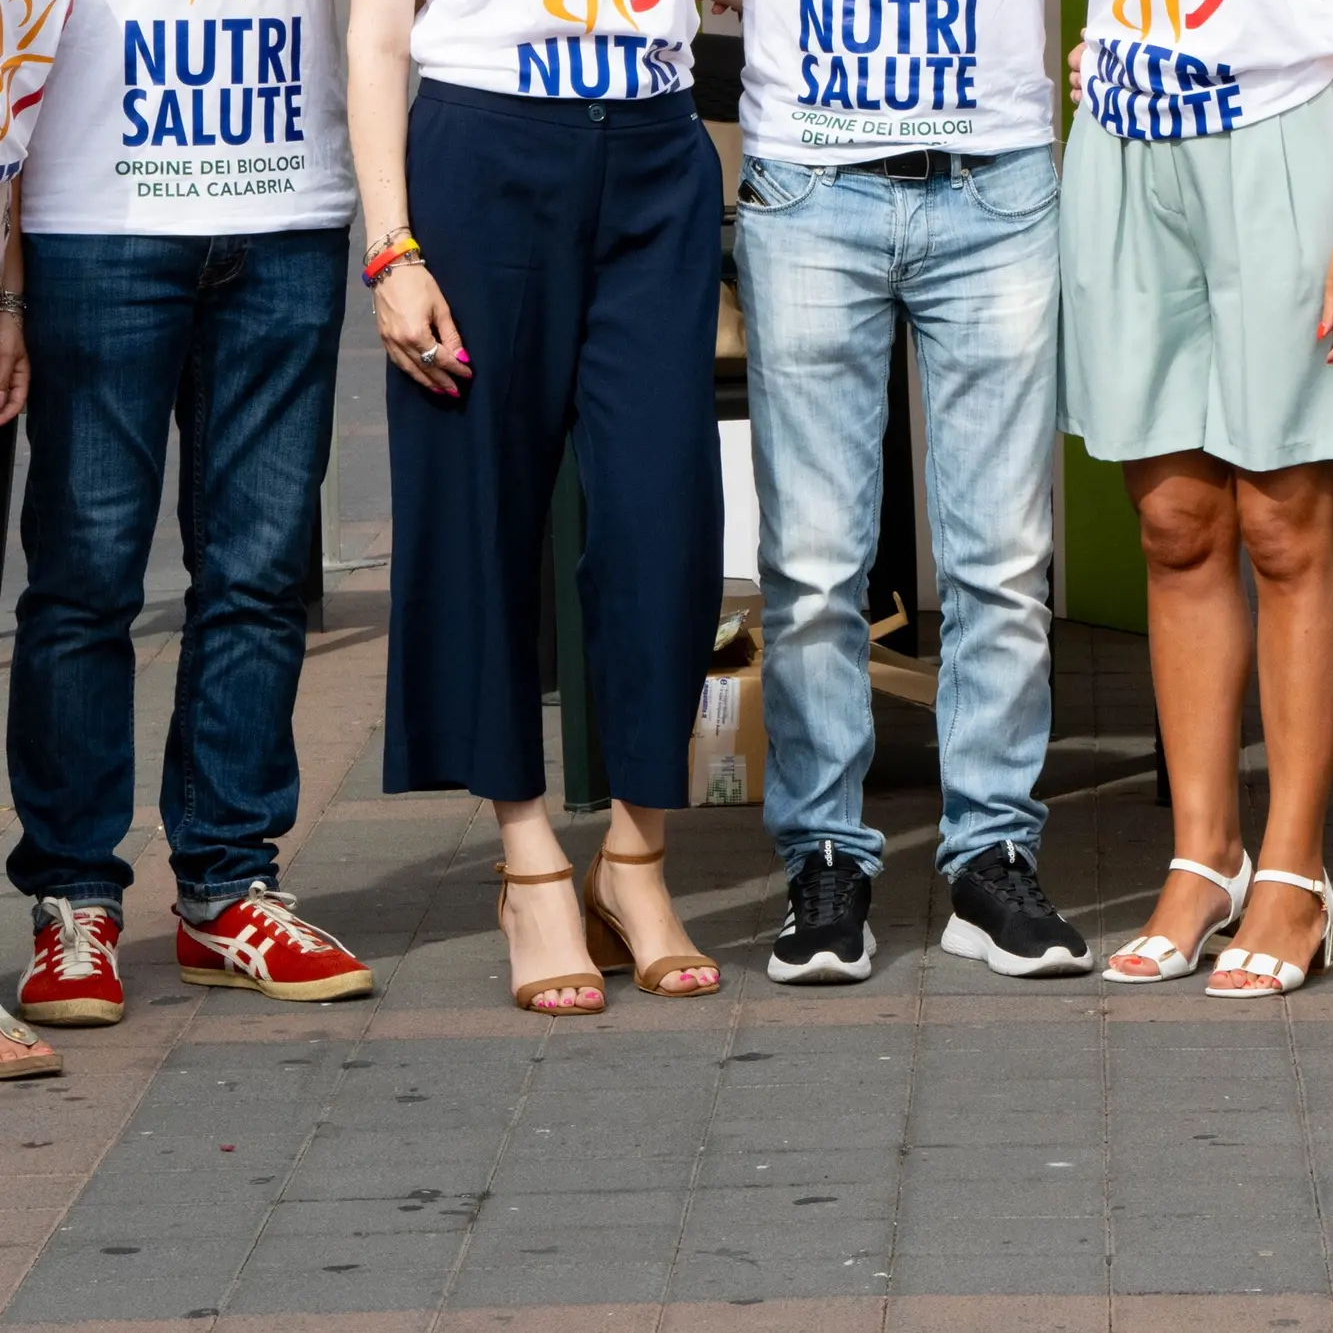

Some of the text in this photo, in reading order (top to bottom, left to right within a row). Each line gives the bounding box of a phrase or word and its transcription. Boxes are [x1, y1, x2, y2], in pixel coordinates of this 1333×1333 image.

[123, 16, 302, 87] NUTRI
[797, 53, 977, 111] SALUTE
[122, 84, 305, 147] SALUTE
[791, 111, 973, 136] ORDINE DEI BIOLOGI
[115, 155, 305, 176] ORDINE DEI BIOLOGI
[137, 178, 295, 197] DELLA CALABRIA
